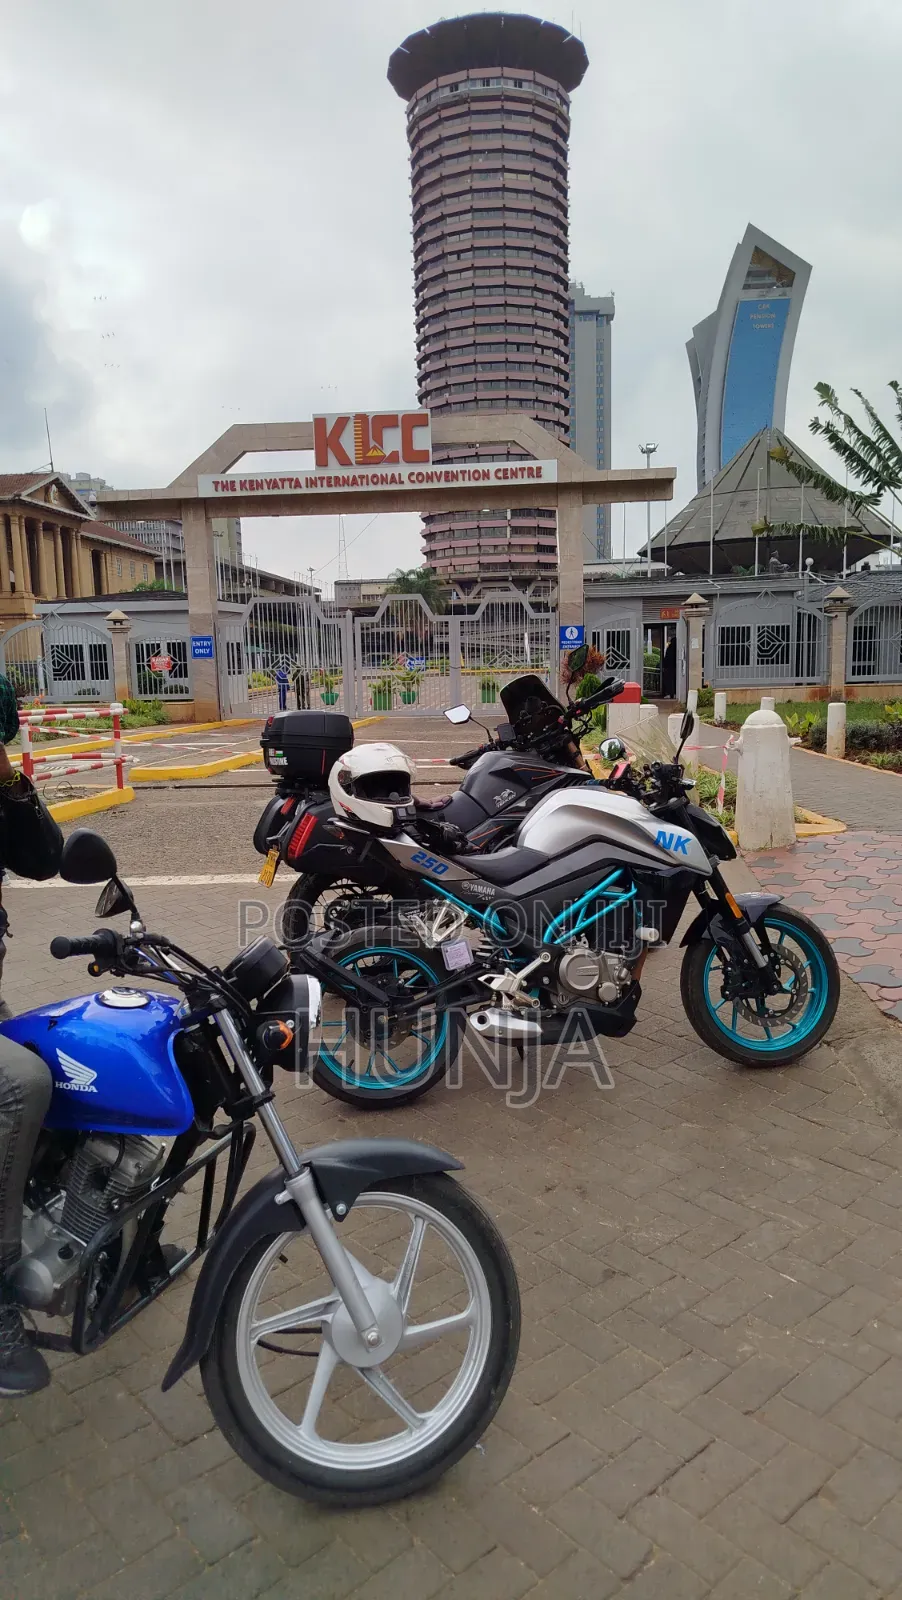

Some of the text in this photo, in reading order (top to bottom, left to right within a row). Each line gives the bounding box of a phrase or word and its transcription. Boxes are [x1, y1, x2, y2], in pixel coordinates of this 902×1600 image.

[313, 413, 430, 467] KICC
[212, 466, 543, 493] THE KENYATTA INTERNATIONAL CONVENTION CENTRE
[653, 830, 692, 855] NK
[410, 850, 449, 875] 250
[470, 883, 496, 896] YAMAHA
[55, 1081, 98, 1093] HONDA
